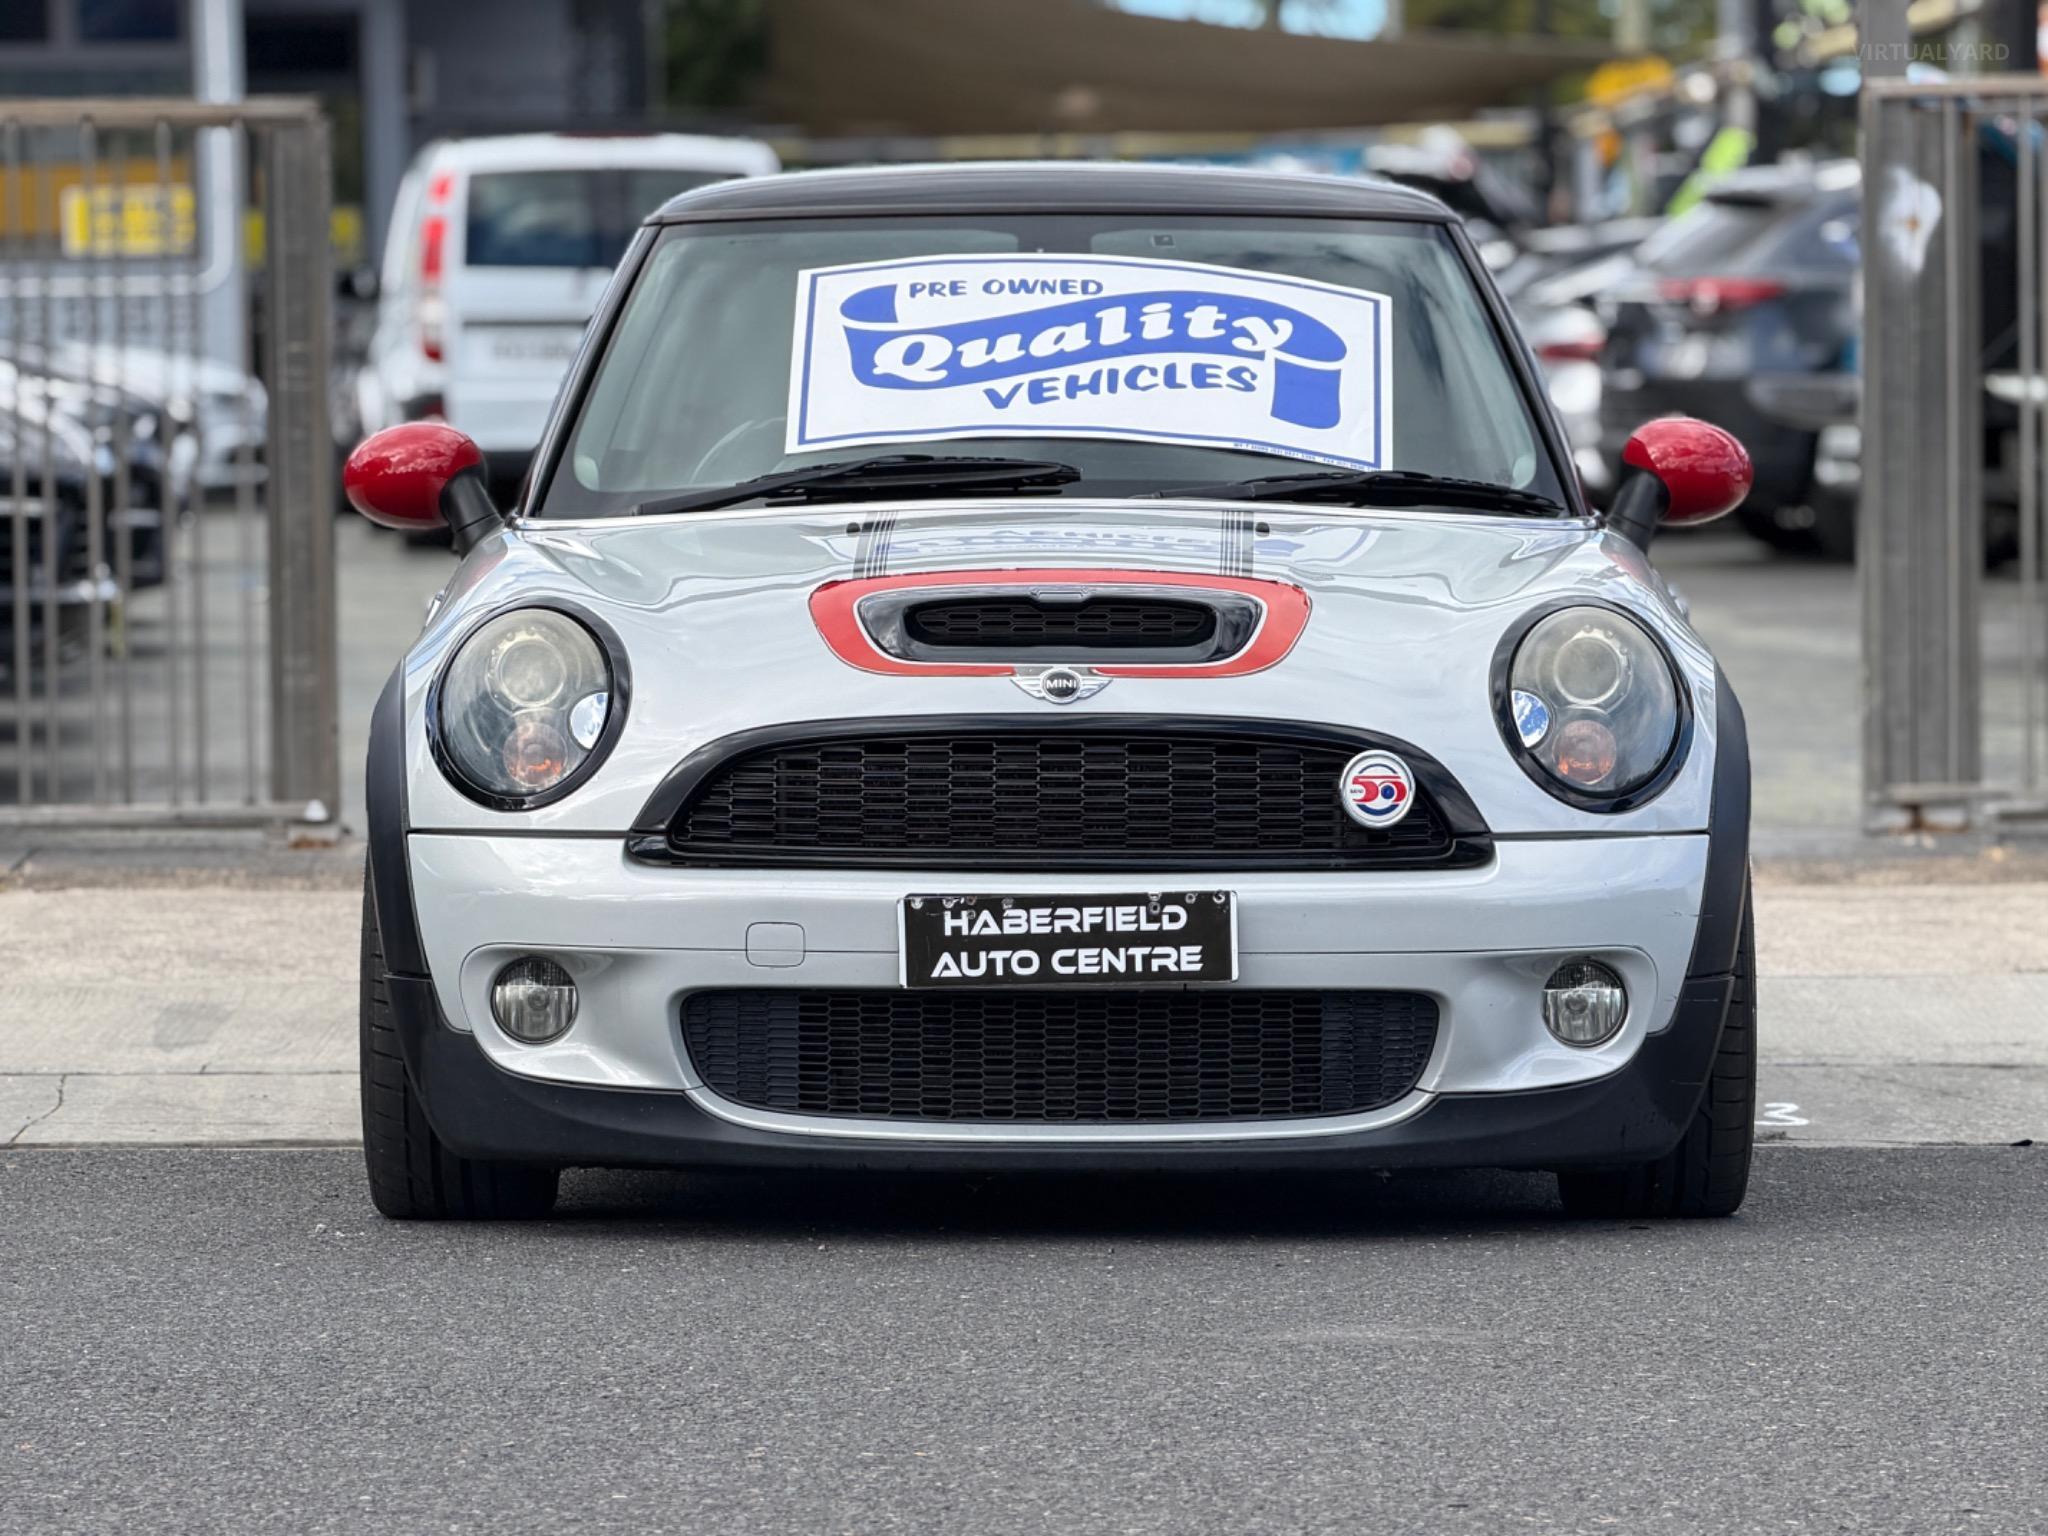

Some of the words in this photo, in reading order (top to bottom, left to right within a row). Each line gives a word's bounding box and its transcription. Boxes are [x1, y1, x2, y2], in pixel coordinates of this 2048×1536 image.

[909, 278, 967, 299] PRE
[983, 276, 1104, 297] OWNED
[872, 300, 1295, 383] Quality
[983, 363, 1259, 410] VEHICLES
[1046, 679, 1077, 689] MINI
[943, 904, 1188, 936] HABERFIELD
[931, 949, 1041, 978] AUTO
[1051, 945, 1204, 975] CENTRE
